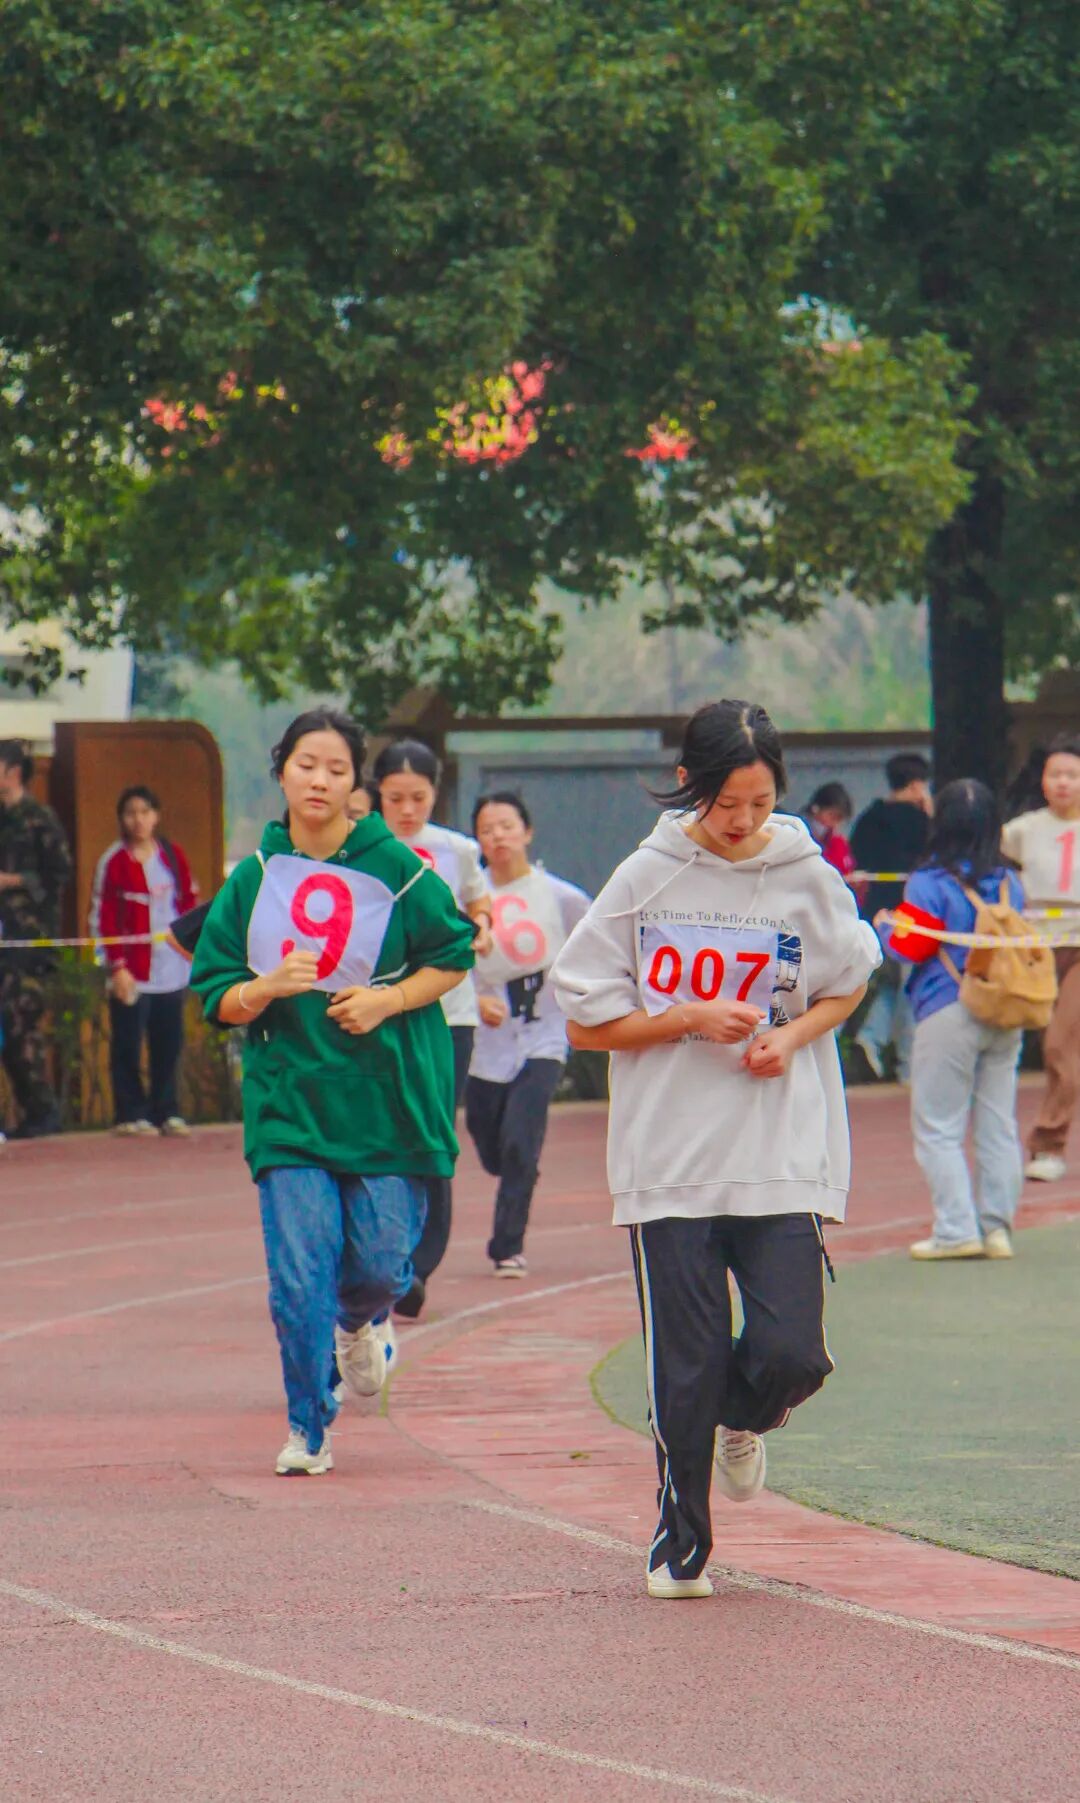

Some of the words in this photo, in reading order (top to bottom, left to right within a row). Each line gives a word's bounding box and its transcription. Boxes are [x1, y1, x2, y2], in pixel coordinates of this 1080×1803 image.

[1056, 831, 1076, 893] 1
[281, 872, 354, 982] 9
[493, 893, 547, 967] 6
[639, 911, 660, 921] It's
[662, 910, 693, 921] Time
[696, 911, 711, 921] To
[760, 916, 777, 928] On
[647, 945, 770, 1002] 007
